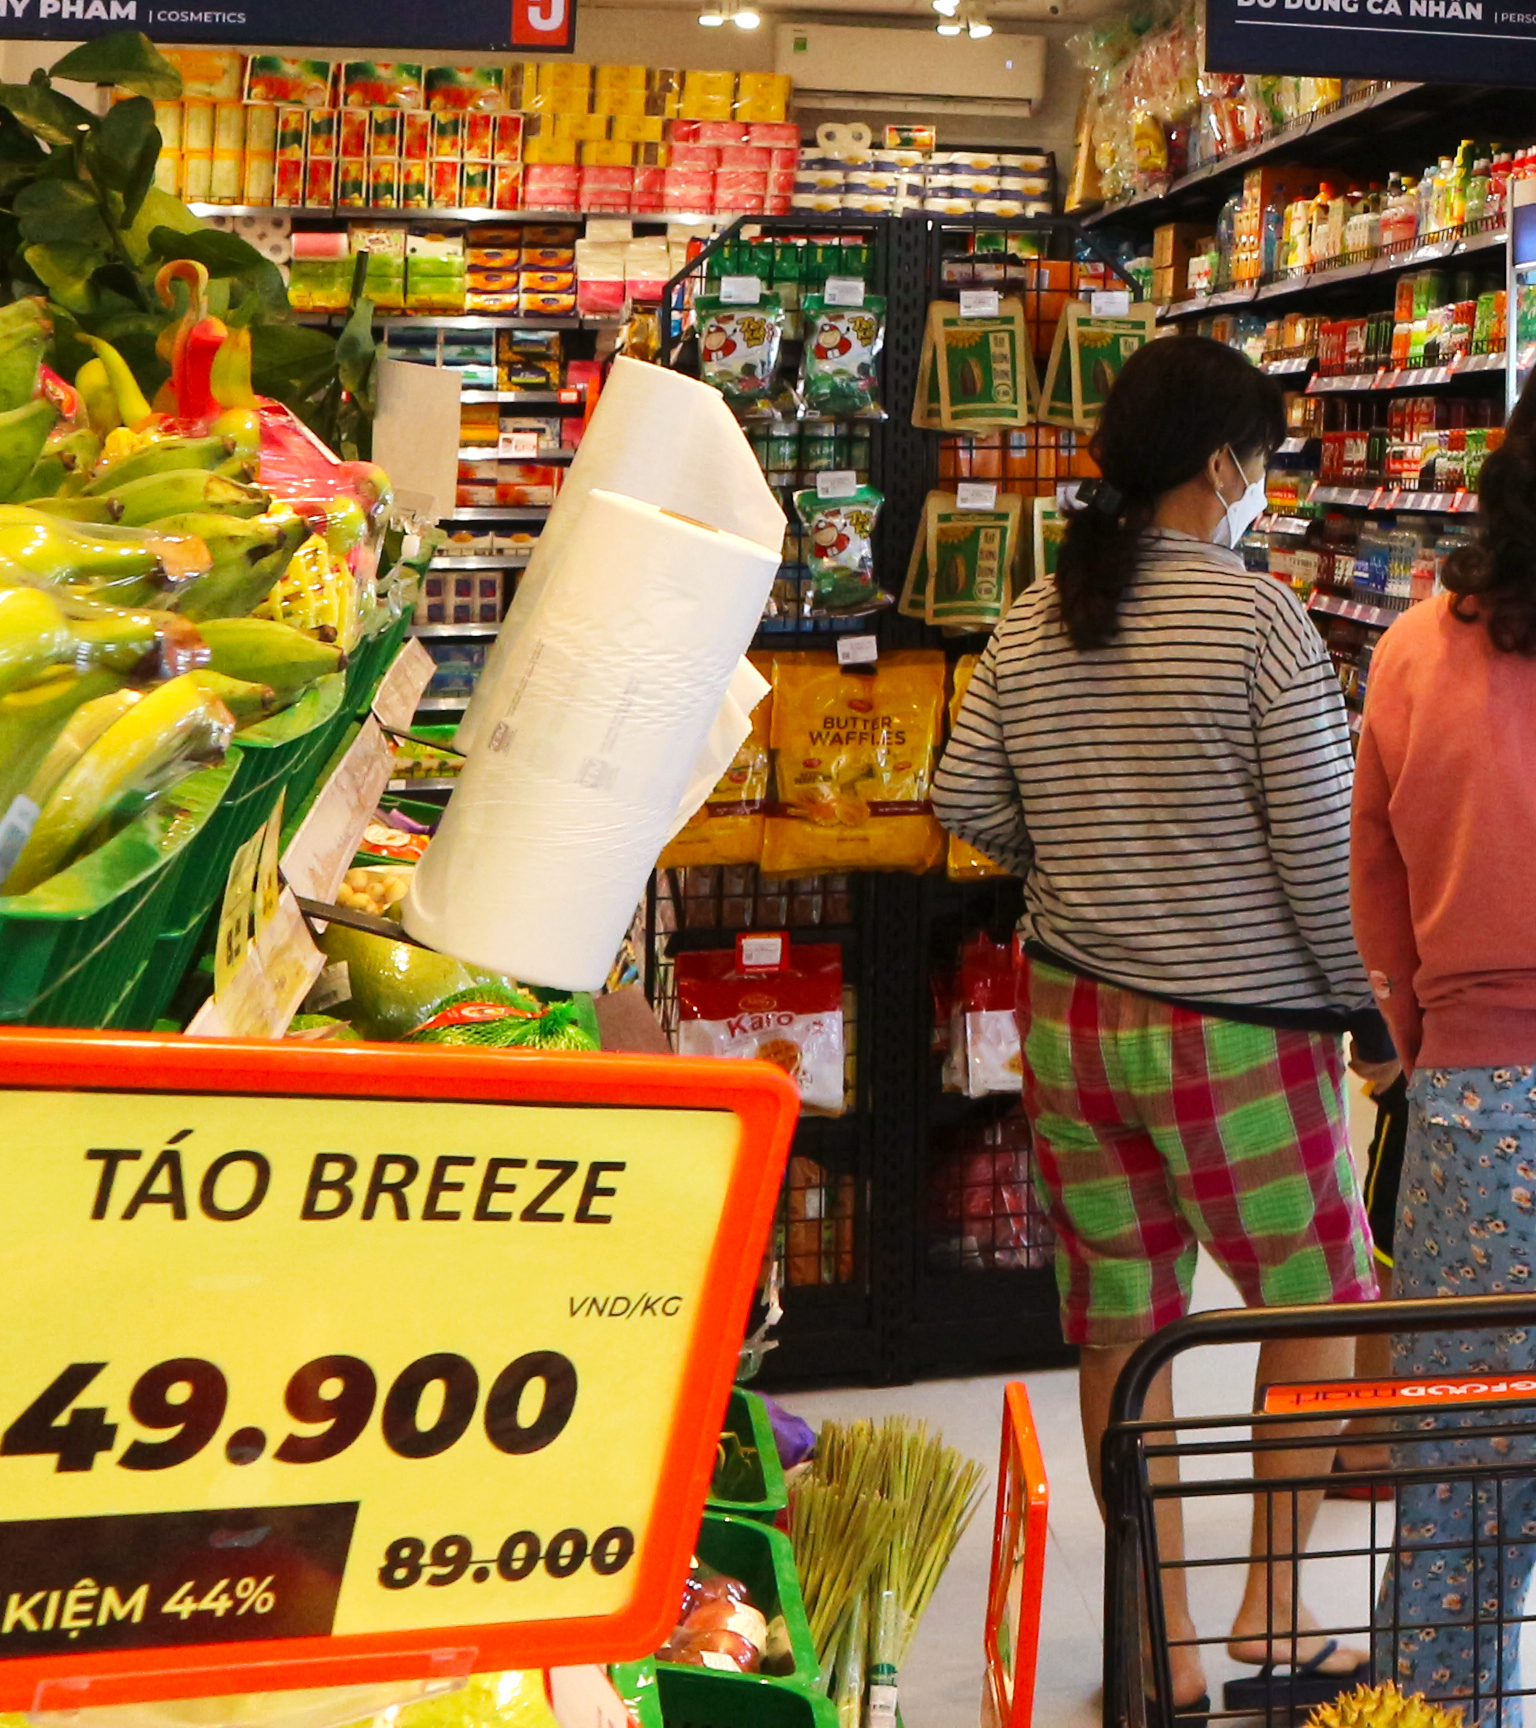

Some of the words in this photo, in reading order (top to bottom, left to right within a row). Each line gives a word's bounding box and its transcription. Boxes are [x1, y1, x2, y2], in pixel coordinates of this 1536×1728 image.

[157, 10, 246, 24] COSMETICS
[823, 716, 893, 731] BUTTER
[808, 730, 906, 747] WAFFLES
[726, 1011, 794, 1039] Karo
[85, 1129, 271, 1222] TÁO
[301, 1151, 626, 1224] BREEZE
[568, 1295, 684, 1321] VND/KG
[2, 1351, 579, 1474] 49.900
[378, 1526, 634, 1591] 89.000
[2, 1582, 149, 1637] KIỆM
[160, 1575, 276, 1618] 44%
